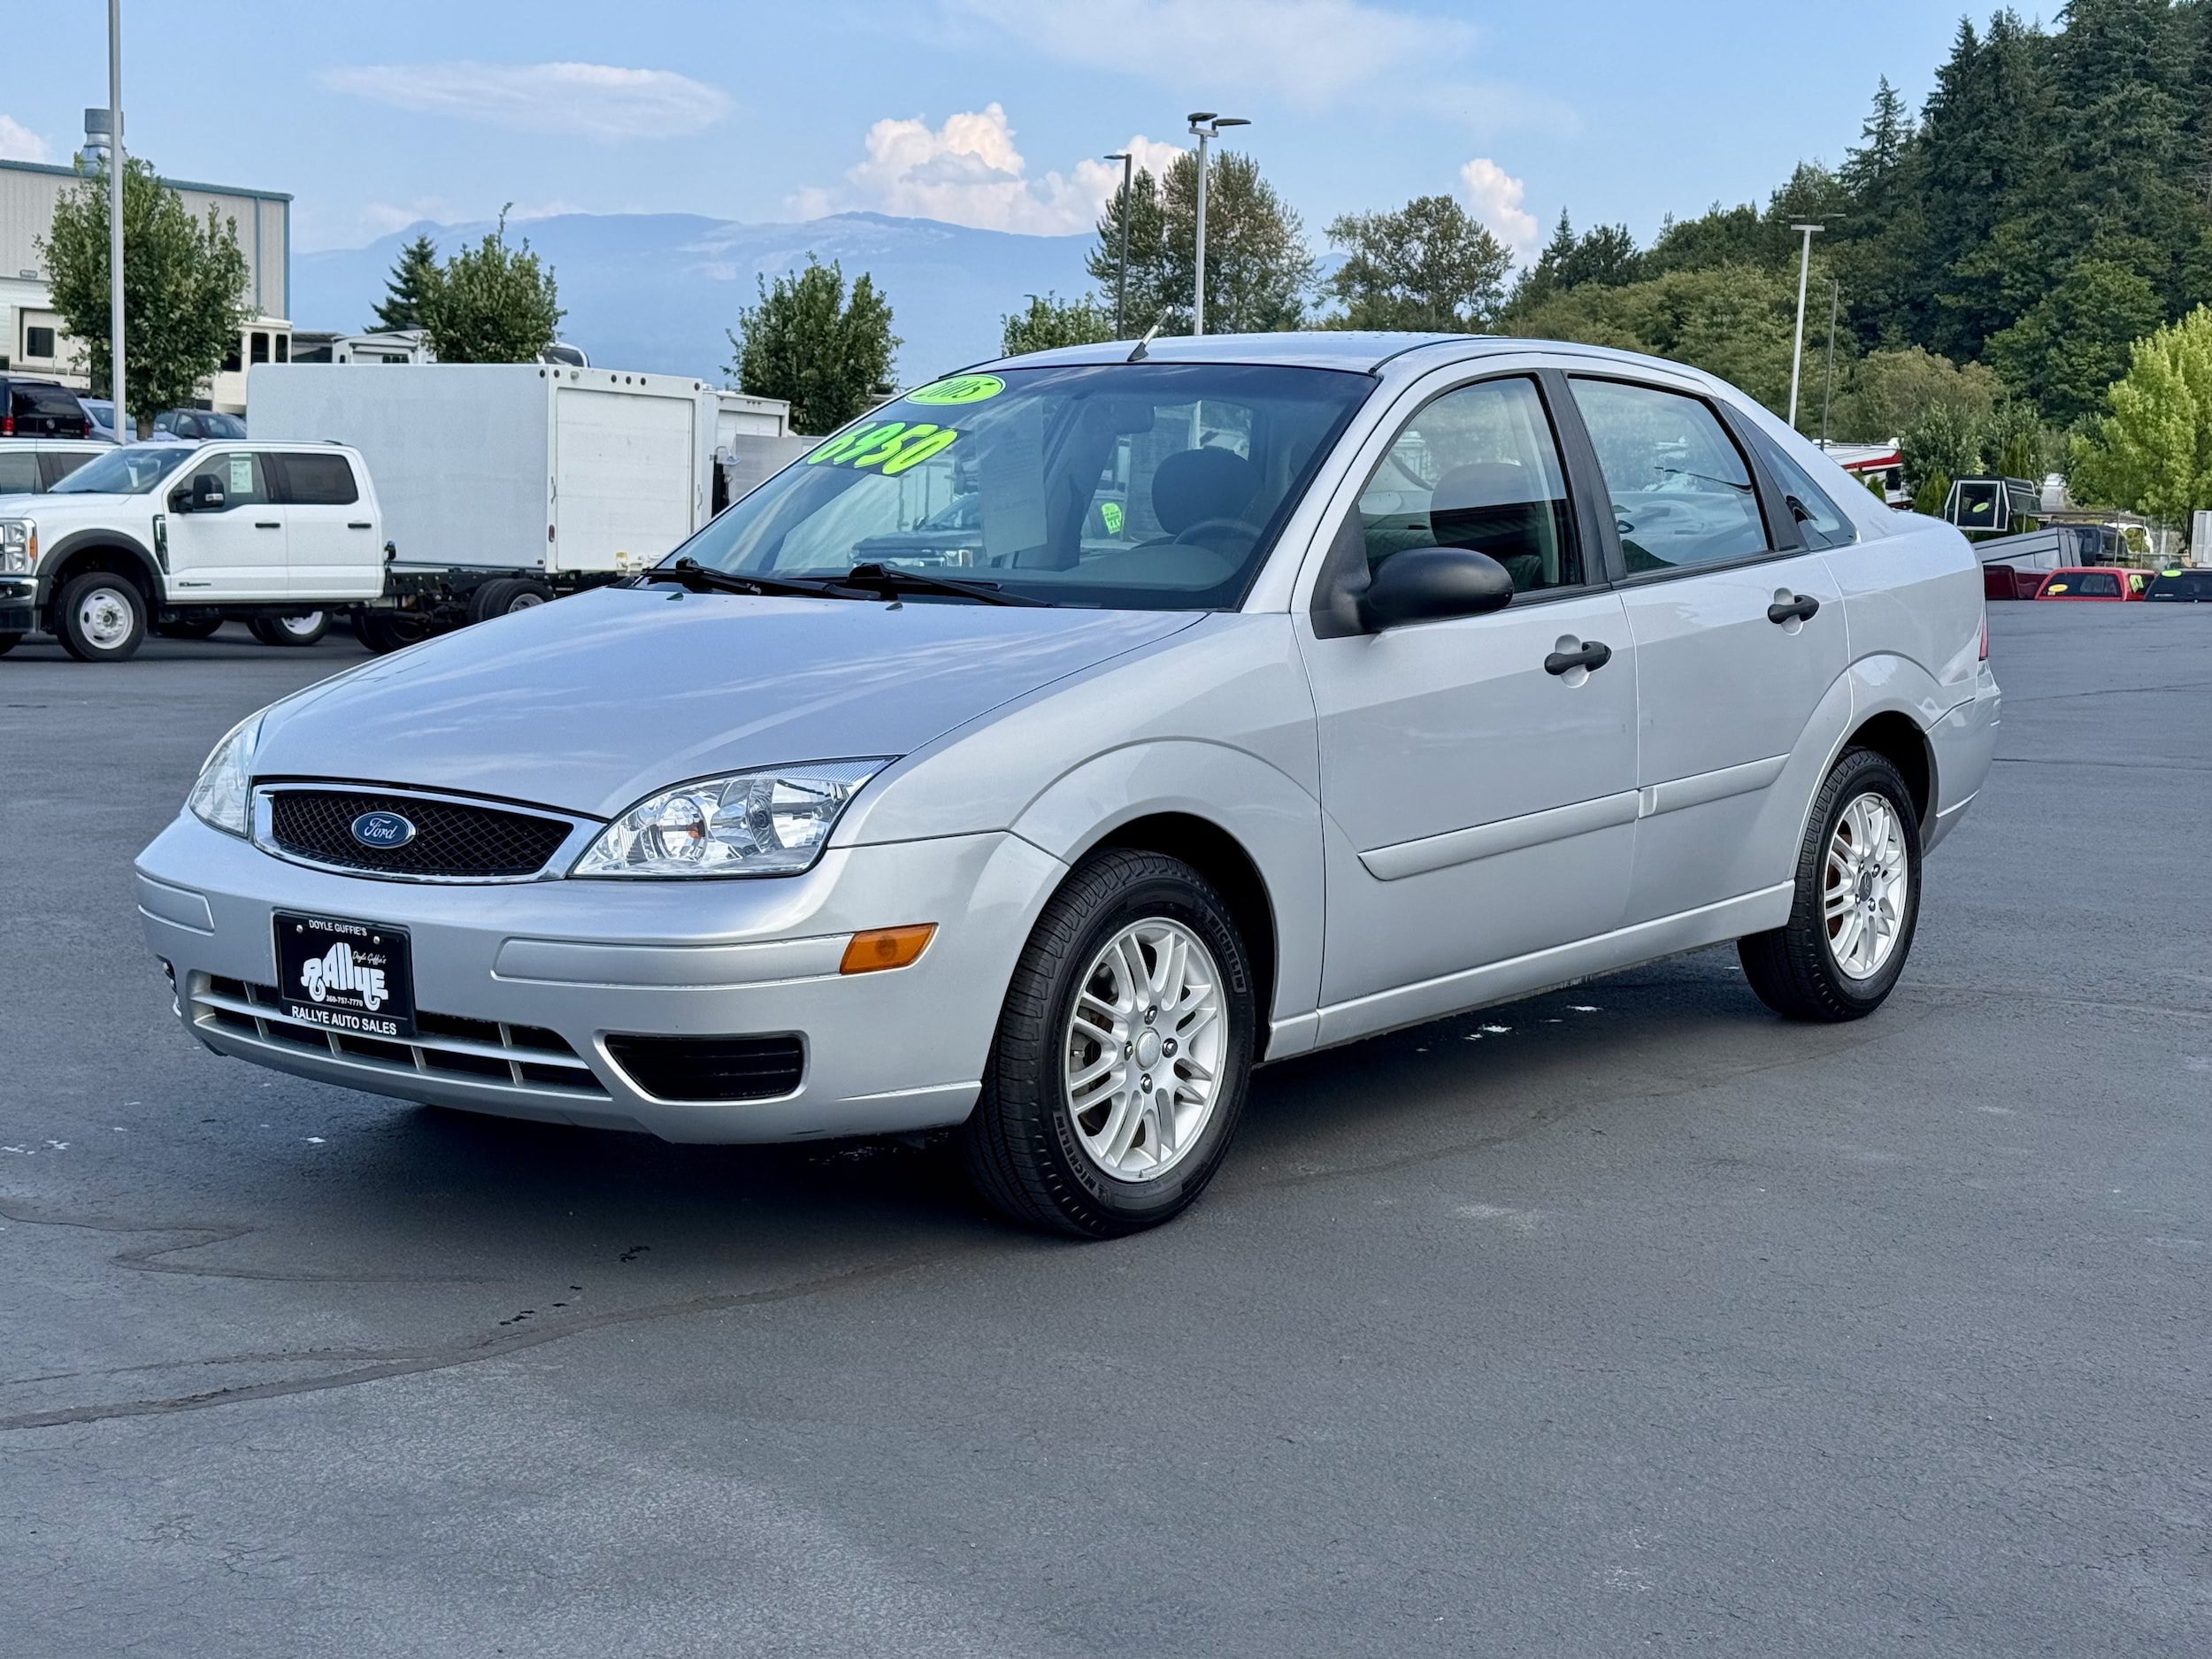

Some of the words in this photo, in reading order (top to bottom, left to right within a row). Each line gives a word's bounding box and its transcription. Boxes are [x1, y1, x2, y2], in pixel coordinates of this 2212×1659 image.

[807, 422, 957, 475] 6950
[364, 817, 398, 840] Ford
[309, 919, 334, 931] DOYLE
[334, 924, 367, 936] GUFFIE'S
[1207, 914, 1245, 989] MICHELIN
[292, 1005, 330, 1024] RALLYE
[331, 1015, 360, 1029] AUTO
[362, 1019, 397, 1035] SALES
[1055, 1115, 1098, 1192] MICHELIN
